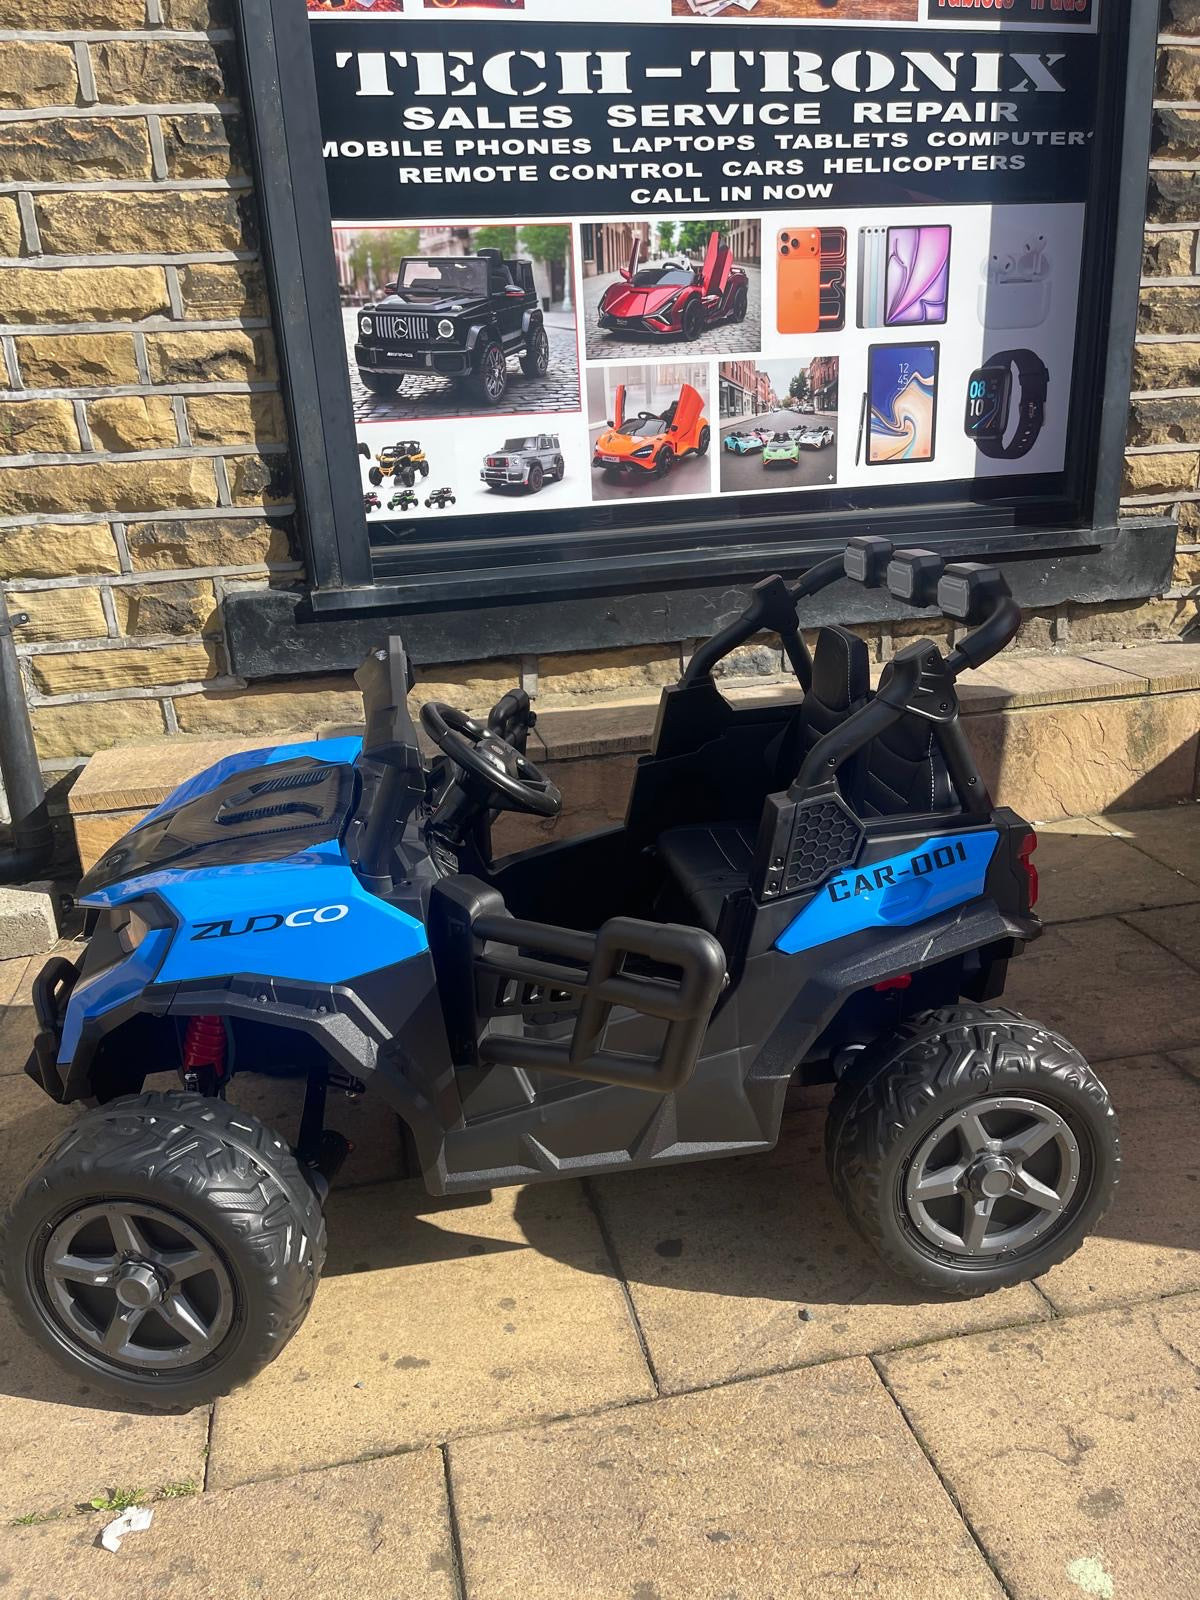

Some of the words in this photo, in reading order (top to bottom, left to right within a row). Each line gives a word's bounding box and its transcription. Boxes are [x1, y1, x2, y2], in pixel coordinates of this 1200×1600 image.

[336, 50, 1065, 97] TECH-TRONIX
[403, 105, 573, 131] SALES
[607, 101, 821, 128] SERVICE
[854, 101, 1019, 124] REPAIR
[321, 139, 443, 158] MOBILE
[456, 138, 592, 156] PHONES
[613, 134, 755, 154] LAPTOPS
[774, 132, 909, 150] TABLETS
[927, 131, 1094, 149] COMPUTER
[399, 164, 538, 184] REMOTE
[549, 161, 702, 182] CONTROL
[722, 158, 804, 177] CARS
[824, 154, 1026, 175] HELICOPTERS
[631, 187, 710, 205] CALL
[721, 185, 751, 202] IN
[763, 182, 833, 201] NOW
[897, 374, 909, 385] 45
[899, 363, 909, 374] 12
[970, 381, 986, 398] 08
[970, 399, 984, 417] 10
[827, 841, 966, 902] CAR-001
[190, 904, 349, 941] ZUDCO
